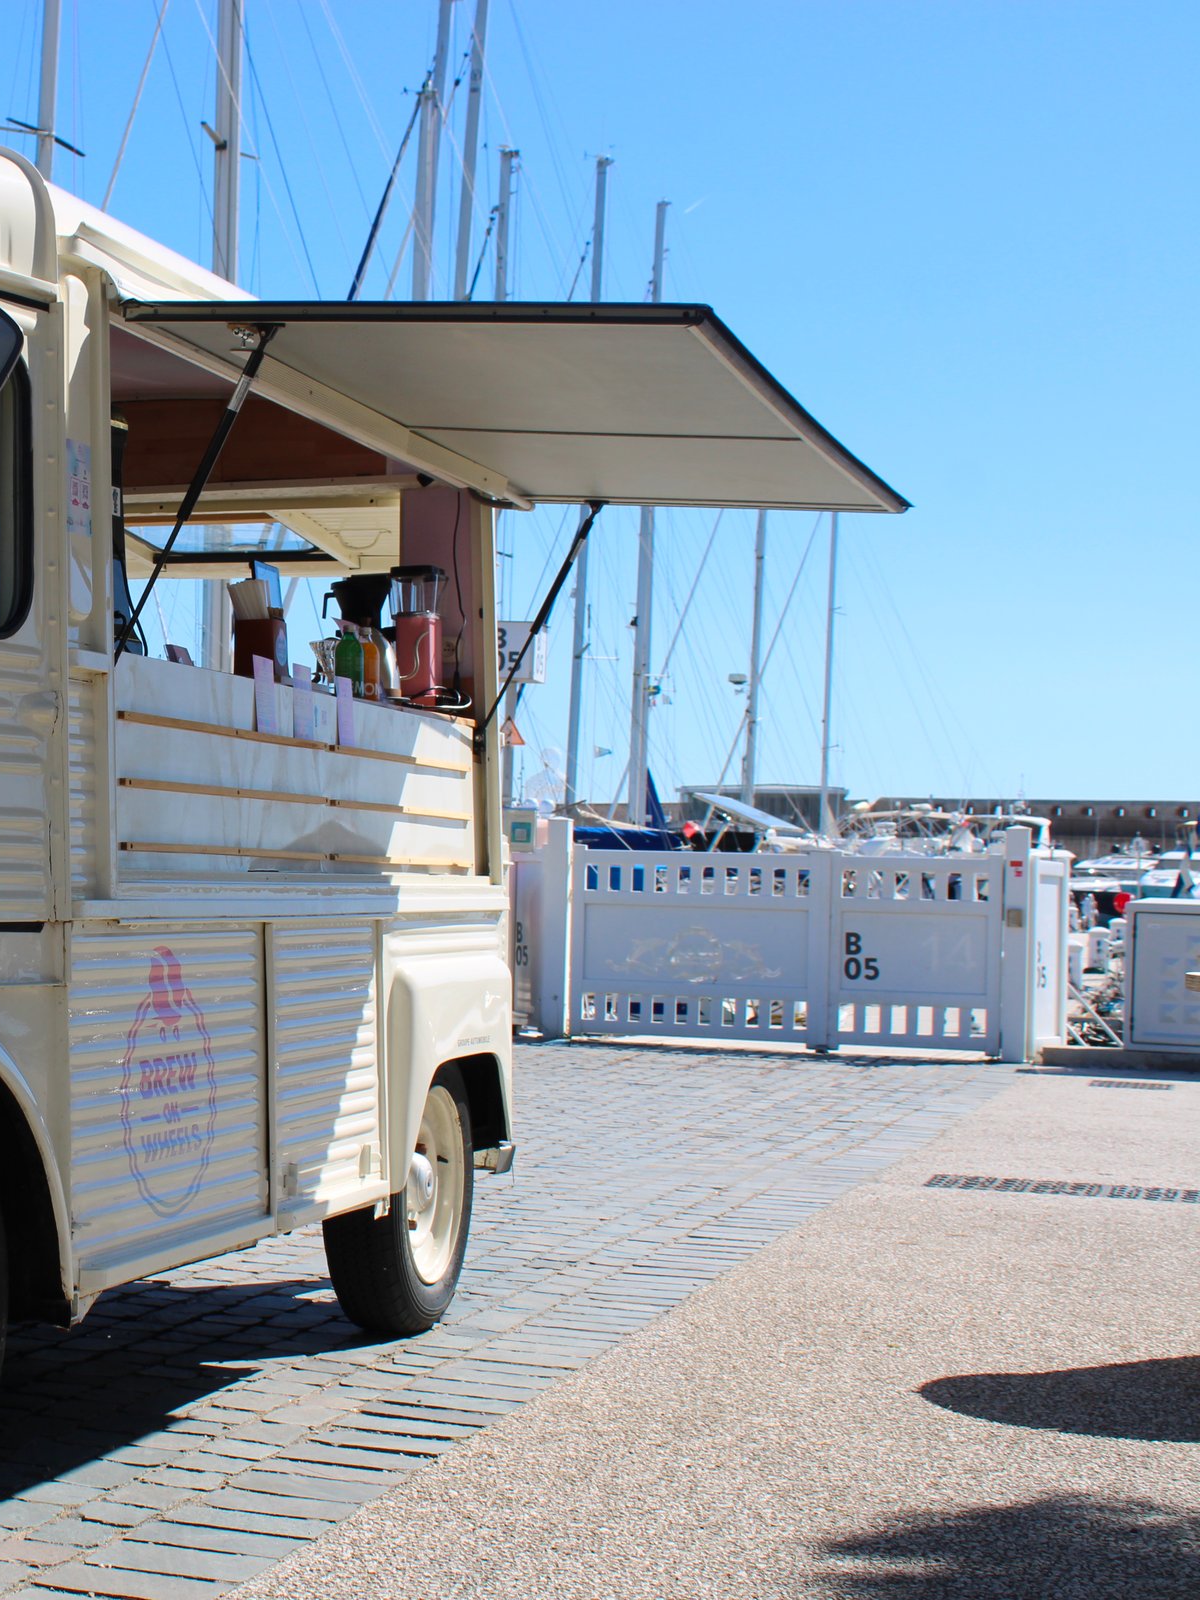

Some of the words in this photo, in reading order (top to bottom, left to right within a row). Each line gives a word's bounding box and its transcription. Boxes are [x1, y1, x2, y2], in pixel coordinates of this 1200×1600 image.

[516, 921, 523, 944] B
[845, 932, 862, 955] B
[516, 944, 529, 967] 05
[844, 957, 880, 980] 05
[139, 1053, 196, 1098] BREW
[163, 1103, 181, 1124] ON
[141, 1124, 201, 1162] WHEELS
